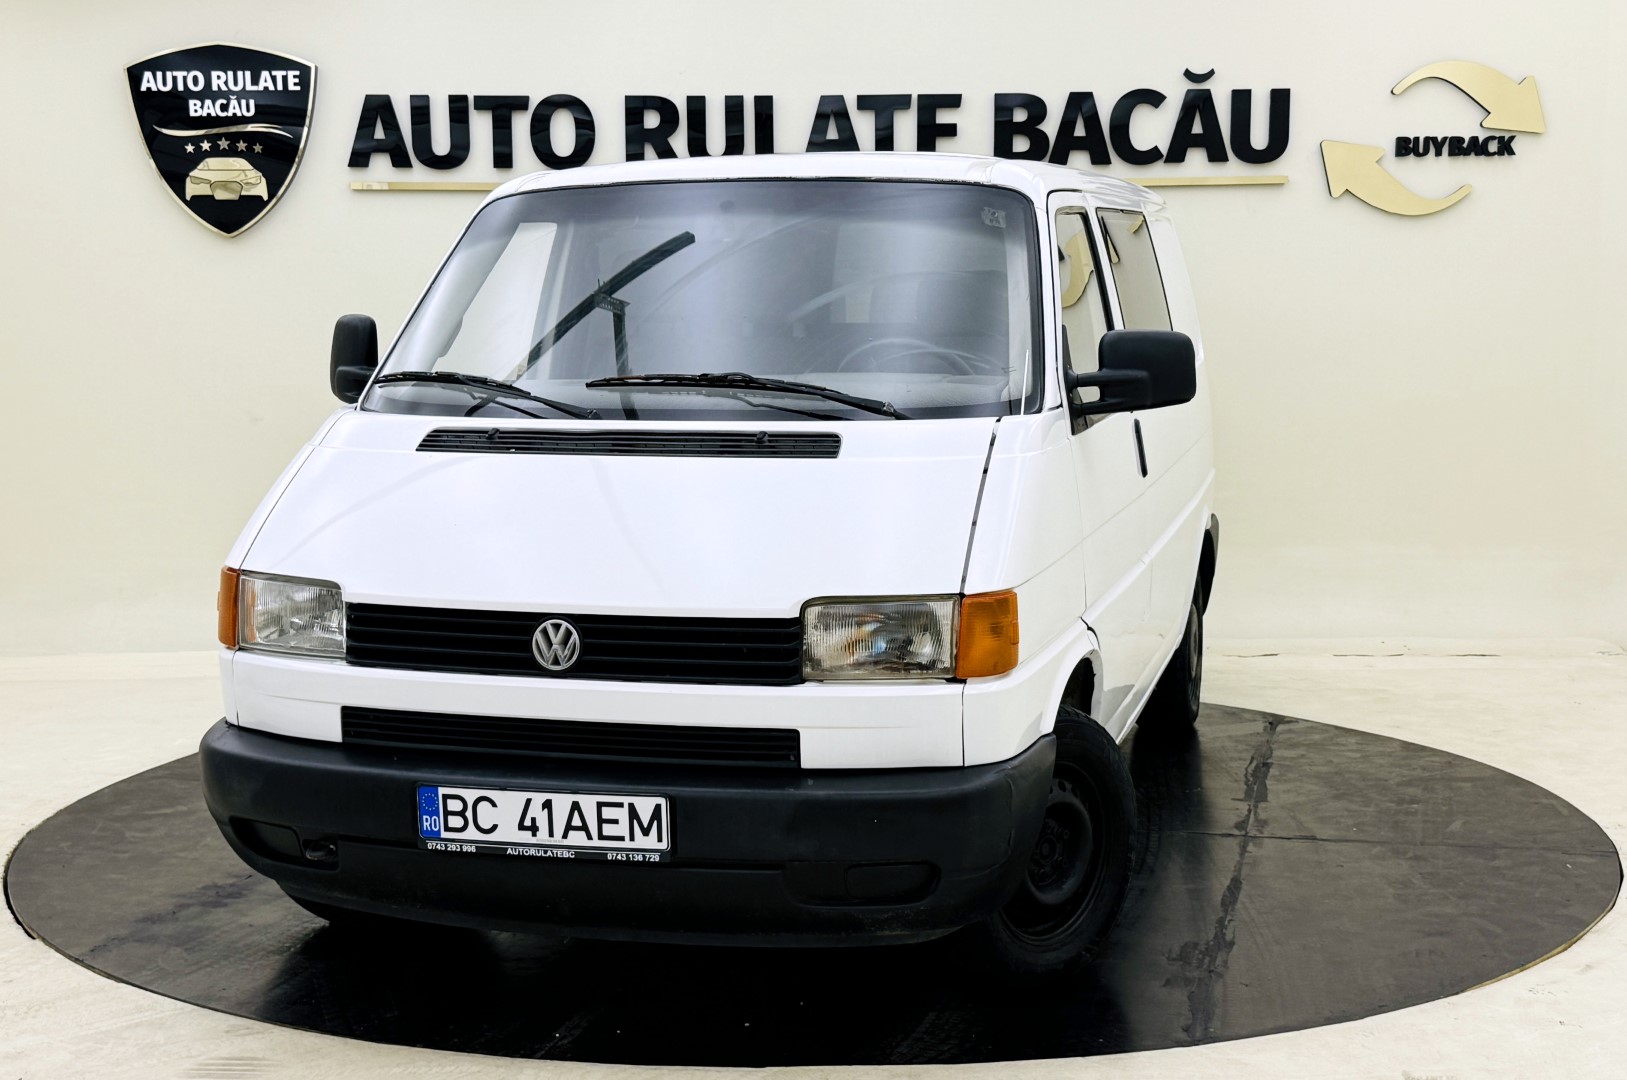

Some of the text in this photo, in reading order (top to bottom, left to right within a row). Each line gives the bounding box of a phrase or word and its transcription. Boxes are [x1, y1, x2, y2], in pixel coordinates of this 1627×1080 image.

[140, 70, 301, 92] AUTO RULATE
[188, 95, 256, 117] BACĂU
[347, 93, 596, 171] AUTO
[993, 67, 1291, 166] BACĂU
[1394, 135, 1517, 157] BUYBACK
[423, 815, 440, 832] RO
[441, 793, 663, 843] BC 41AEM
[427, 842, 476, 853] 0743 293 996
[506, 847, 575, 858] AUTORULATEBC
[607, 853, 627, 861] 0743
[645, 854, 660, 862] 729
